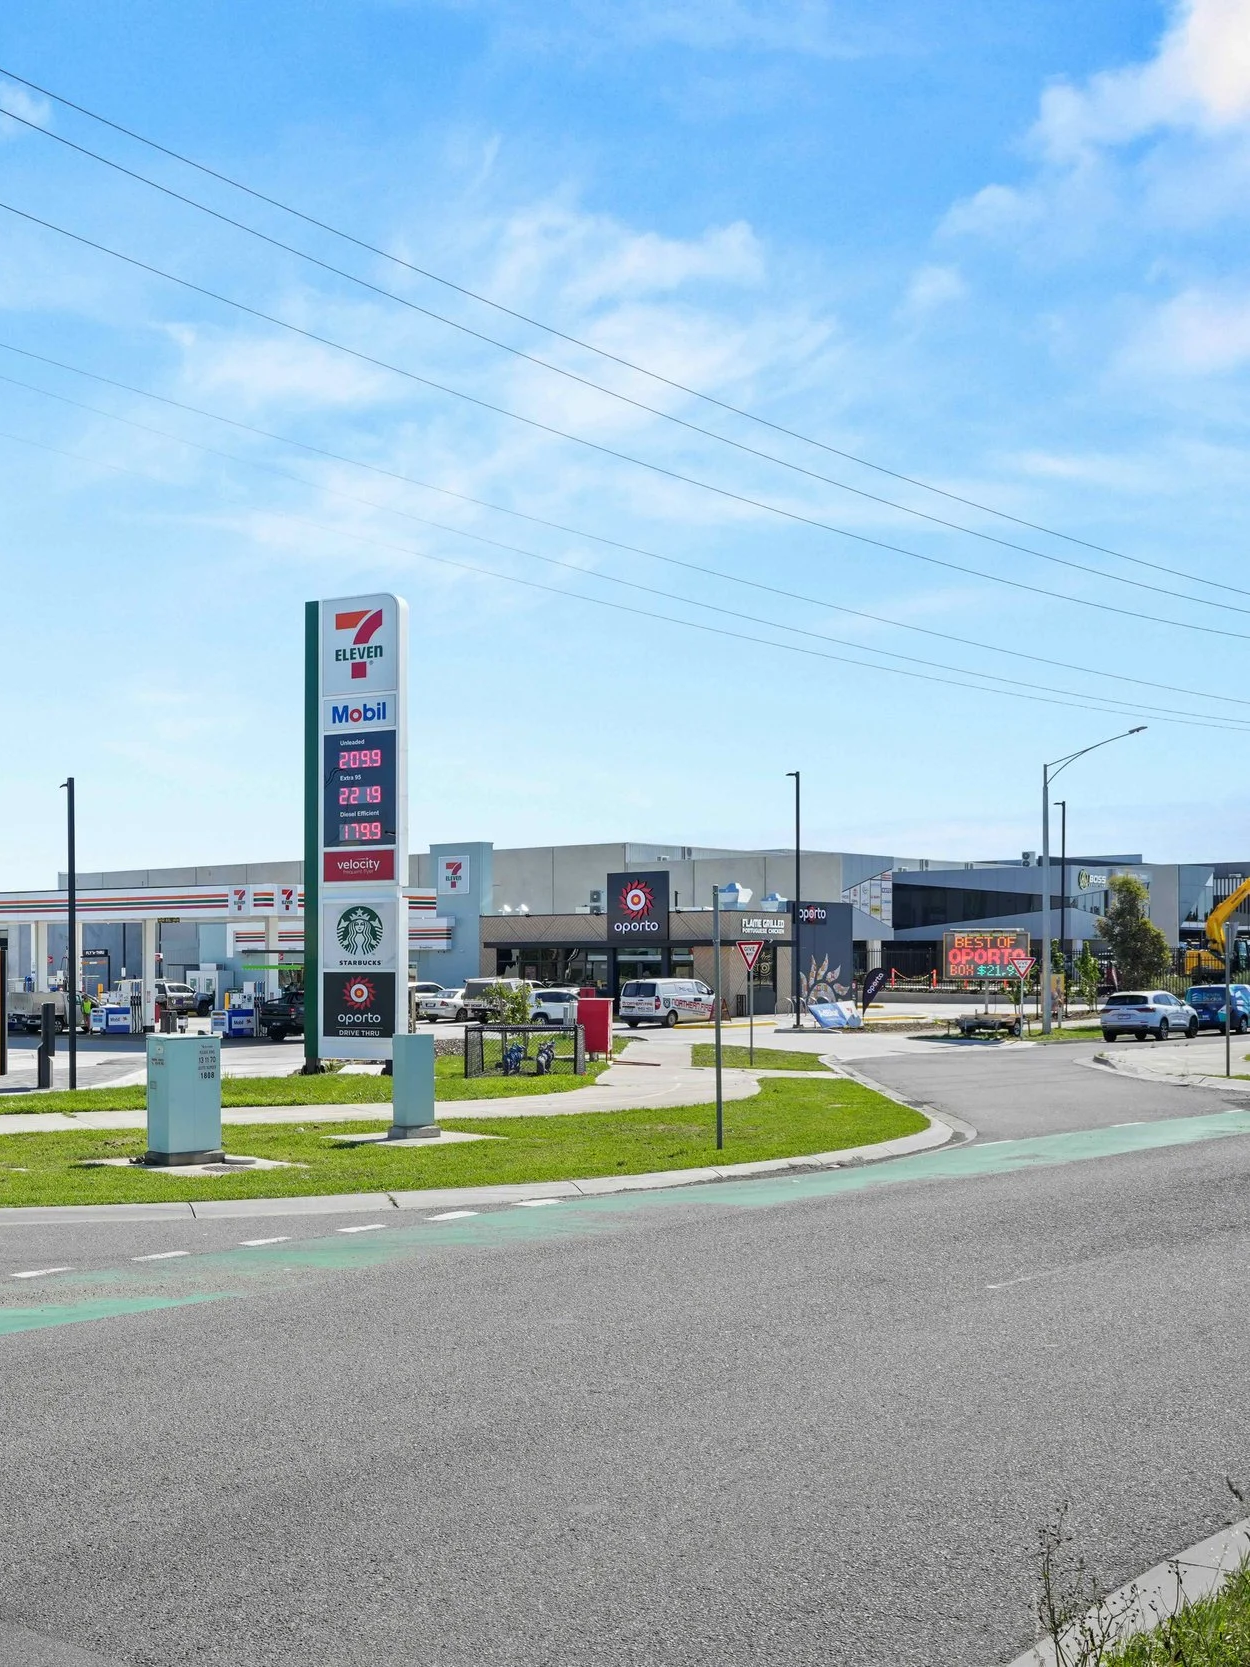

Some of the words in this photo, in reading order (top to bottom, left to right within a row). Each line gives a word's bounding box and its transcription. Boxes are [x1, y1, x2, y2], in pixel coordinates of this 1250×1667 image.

[332, 702, 386, 724] Mobil
[339, 749, 381, 769] 209.9
[339, 786, 381, 805] 221.9
[344, 822, 381, 840] 179.9
[337, 857, 380, 872] velocity
[1090, 874, 1106, 884] BOSS
[614, 920, 658, 934] oporto
[742, 919, 762, 928] FLAME
[763, 920, 784, 928] GRILLED
[954, 936, 993, 948] BEST
[998, 936, 1016, 948] OF
[950, 965, 974, 976] BOX
[867, 972, 884, 994] oporto
[672, 998, 701, 1009] NORTHERN
[338, 1012, 381, 1025] oporto
